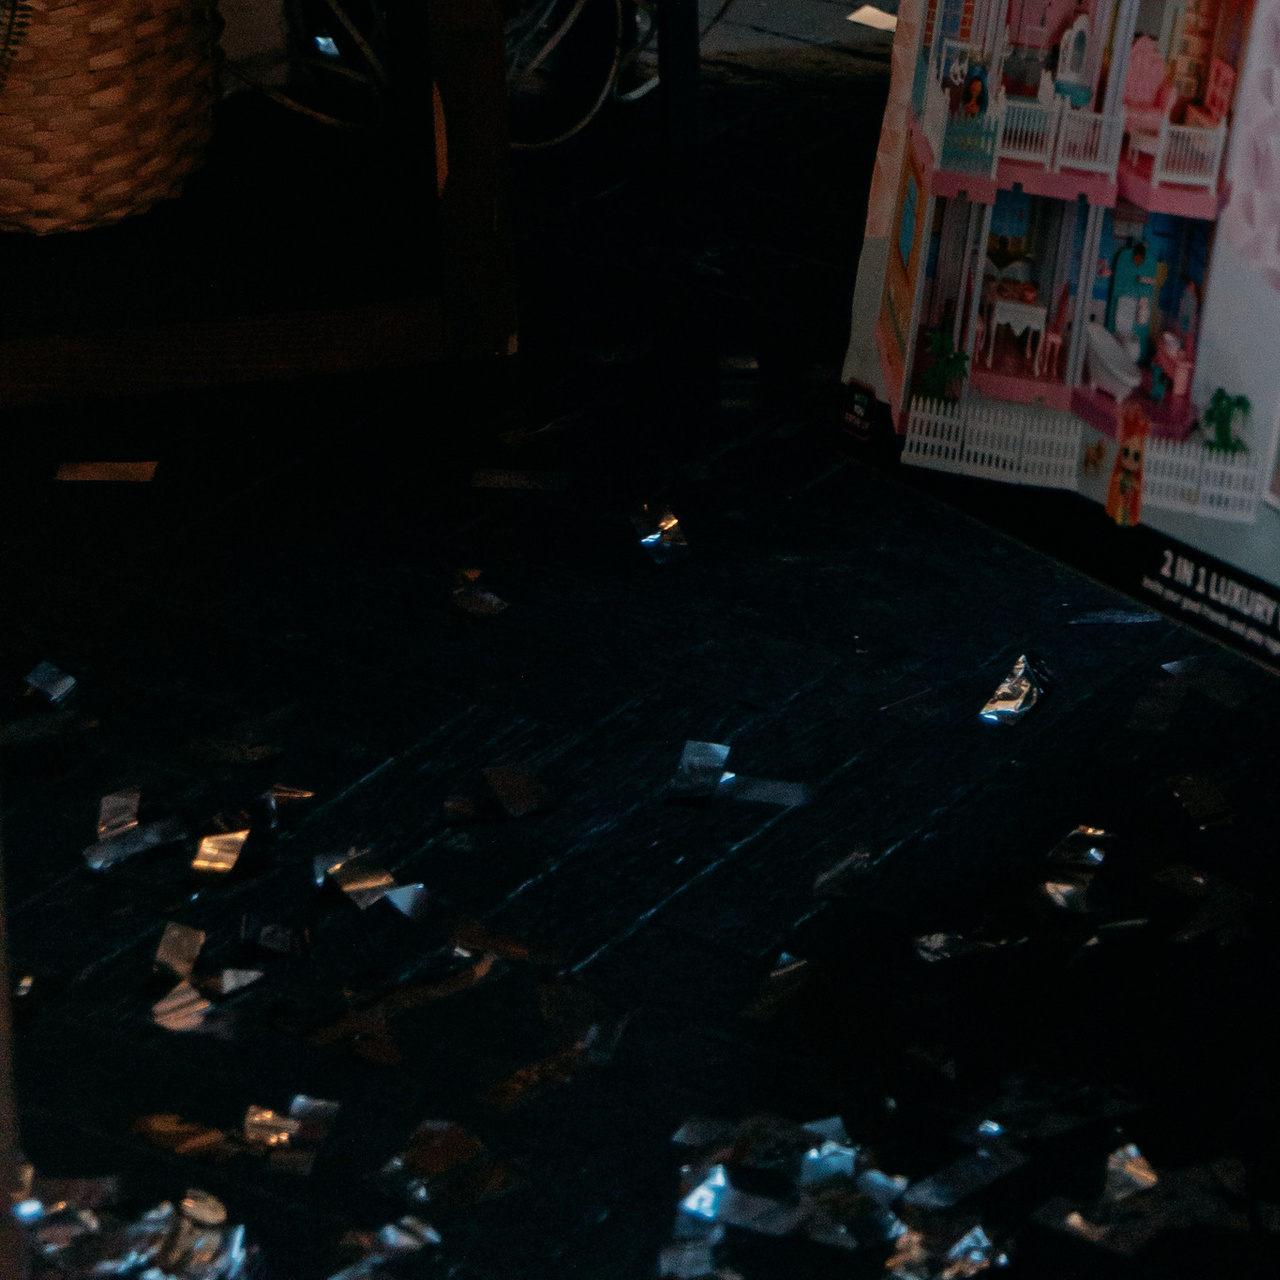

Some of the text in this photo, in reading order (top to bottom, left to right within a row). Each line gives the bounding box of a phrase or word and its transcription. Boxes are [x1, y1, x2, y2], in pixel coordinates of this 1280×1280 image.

[1160, 548, 1175, 579] 2
[1174, 555, 1196, 588] IN
[1195, 565, 1207, 595] 1
[1208, 571, 1278, 625] LUXURY
